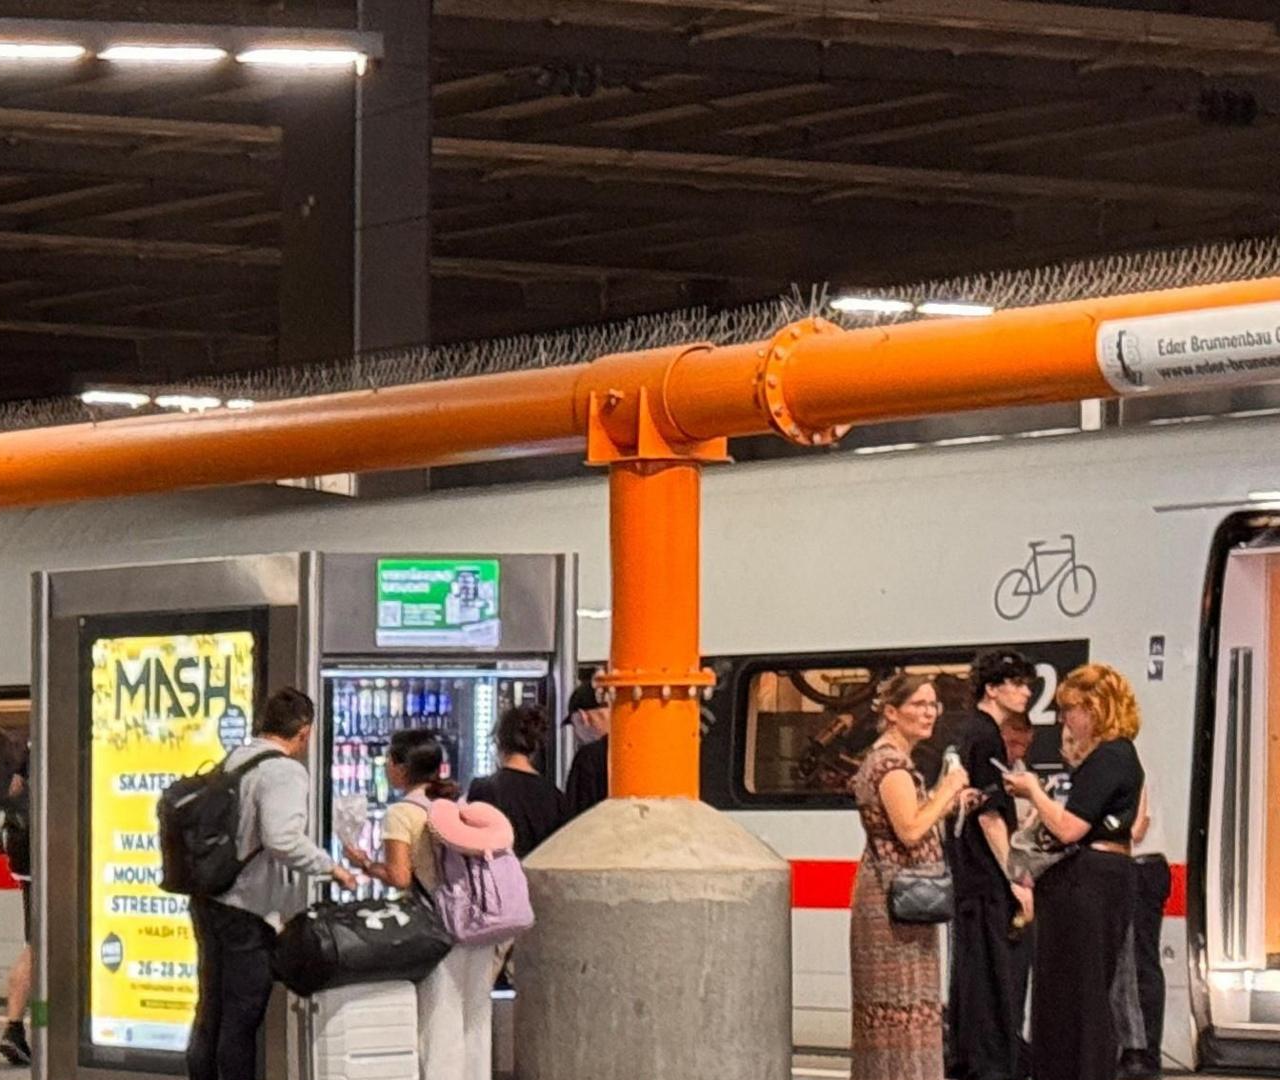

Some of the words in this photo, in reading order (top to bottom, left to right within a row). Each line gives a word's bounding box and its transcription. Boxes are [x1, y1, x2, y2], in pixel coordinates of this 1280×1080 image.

[1157, 338, 1188, 356] Eder
[1191, 329, 1272, 352] Brunnenbau
[115, 655, 232, 720] MASH
[1028, 663, 1057, 725] 2
